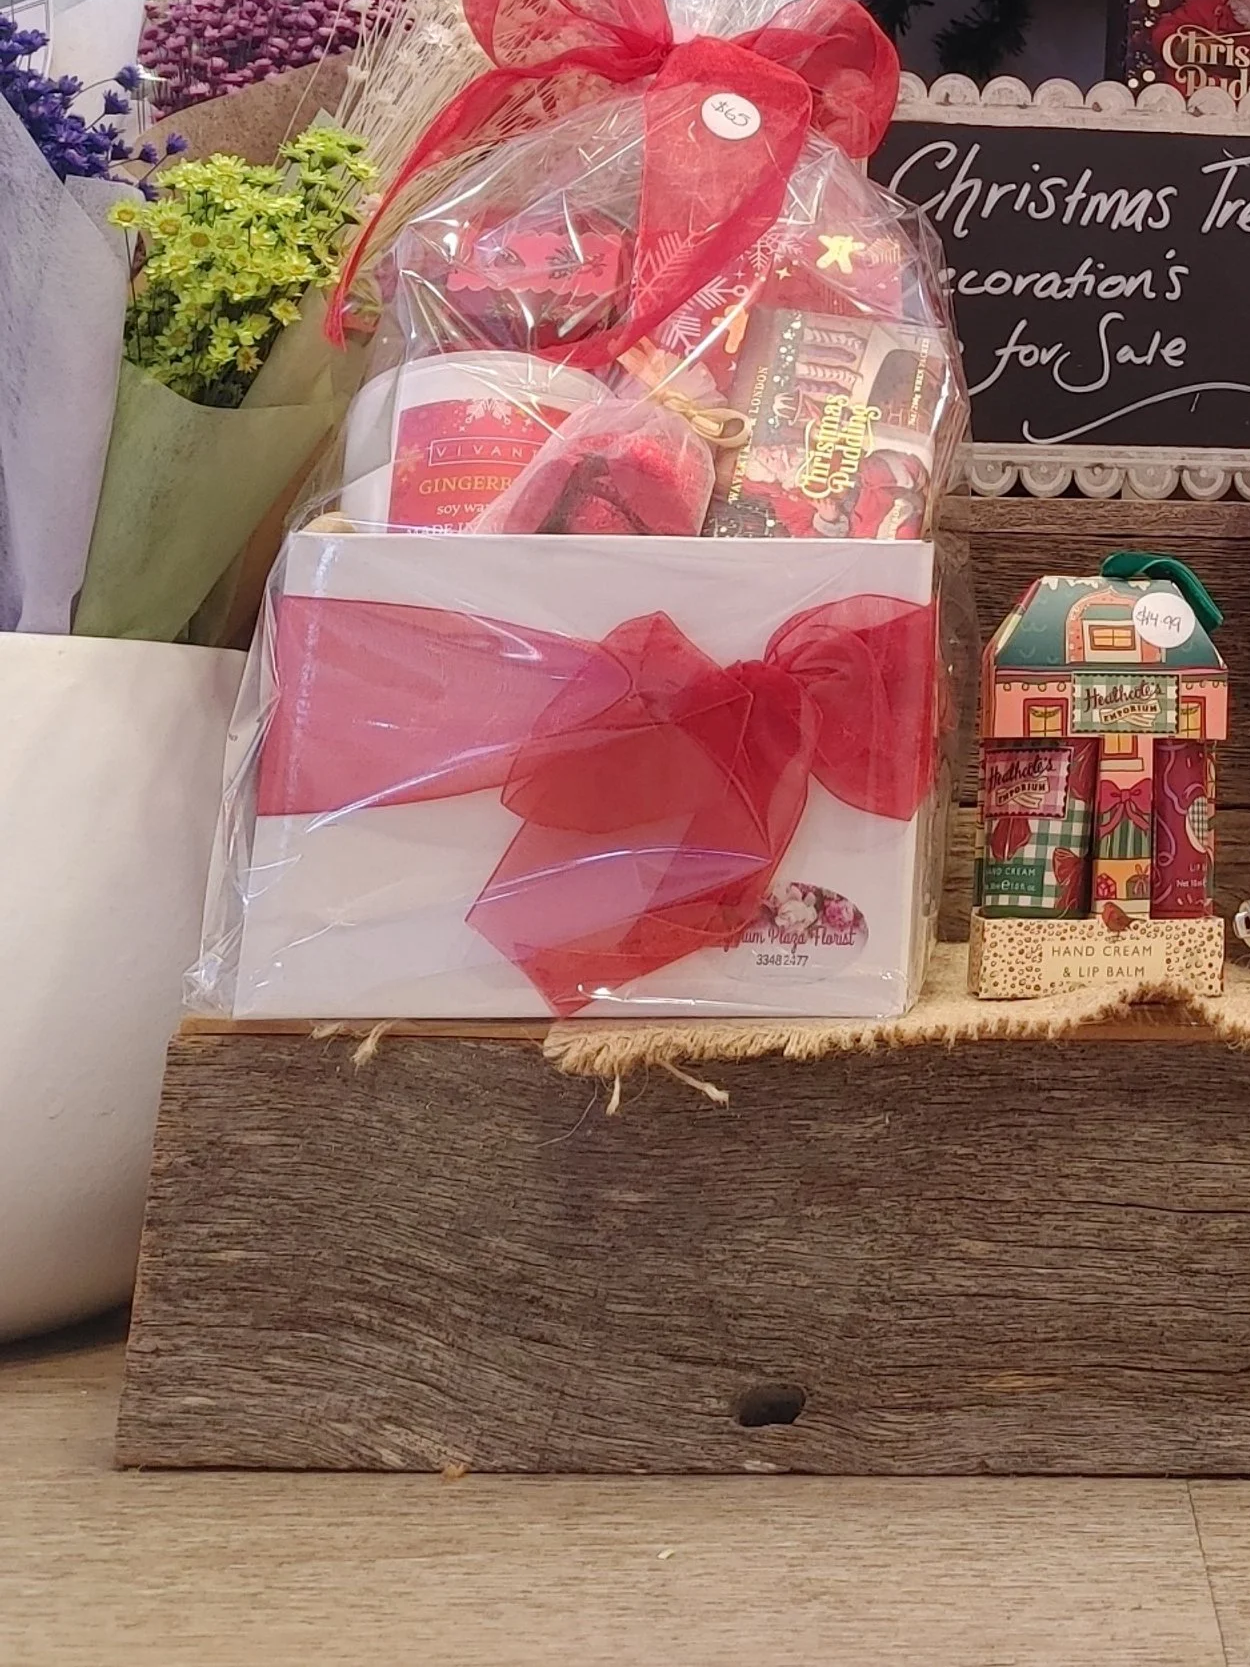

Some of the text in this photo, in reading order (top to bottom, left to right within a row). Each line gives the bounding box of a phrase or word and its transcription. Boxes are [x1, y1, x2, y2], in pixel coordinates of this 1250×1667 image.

[889, 140, 1177, 238] Christmas
[966, 312, 1188, 396] for Sale
[748, 365, 769, 415] LONDON
[797, 394, 850, 500] Christmas
[826, 402, 882, 494] Pudding
[436, 502, 461, 517] soy
[1083, 678, 1165, 713] Heathcote's
[1101, 704, 1159, 724] EMPORIUM
[988, 754, 1058, 792] Heathcote's
[996, 782, 1047, 804] EMPORIUM
[1004, 867, 1037, 877] CREAM
[768, 927, 807, 954] Plaza
[809, 926, 857, 947] Florist
[1051, 945, 1153, 957] HAND CREAM
[1062, 966, 1146, 978] & LIP BALM
